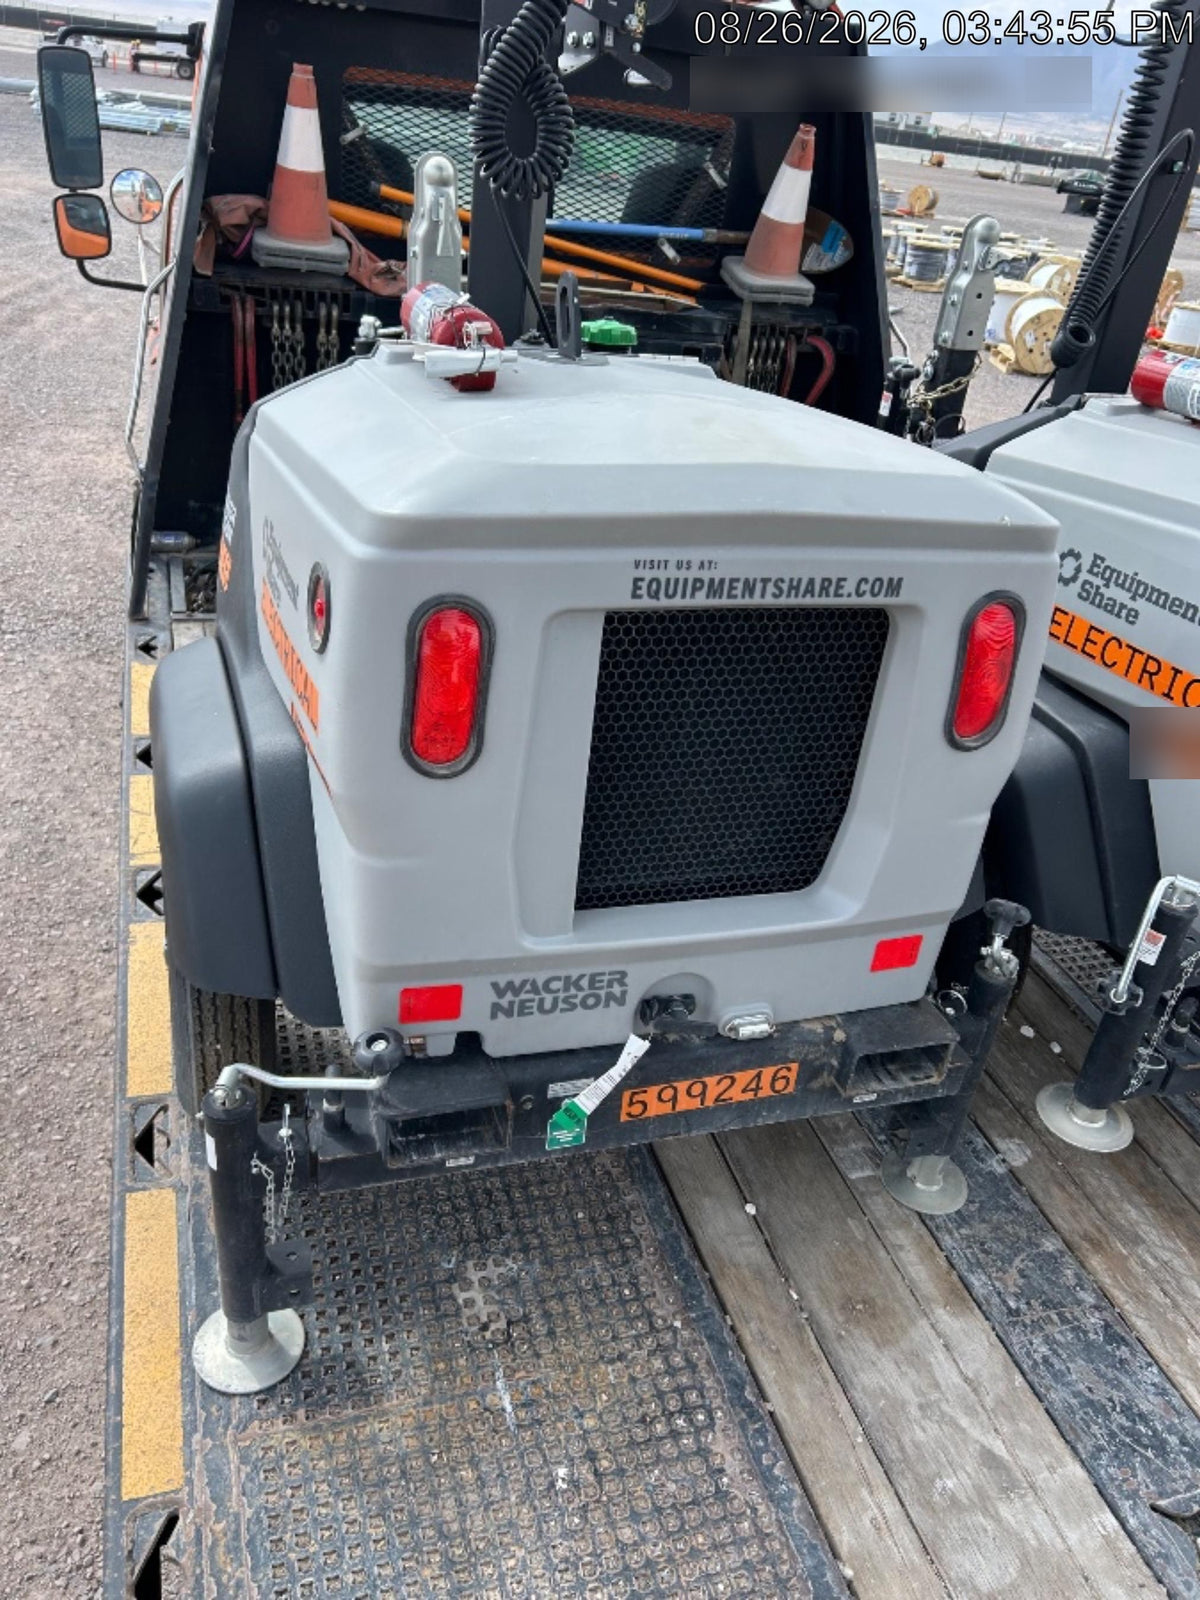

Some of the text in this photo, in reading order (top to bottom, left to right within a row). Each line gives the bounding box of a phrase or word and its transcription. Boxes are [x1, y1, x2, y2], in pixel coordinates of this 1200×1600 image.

[634, 560, 718, 570] VISIT US AT:
[631, 577, 904, 601] EQUIPMENTSHARE.COM
[1077, 579, 1140, 626] Share
[1086, 553, 1200, 626] Equipmen
[490, 970, 629, 1000] WACKER
[490, 989, 628, 1021] NEUSON
[625, 1066, 793, 1119] 599246
